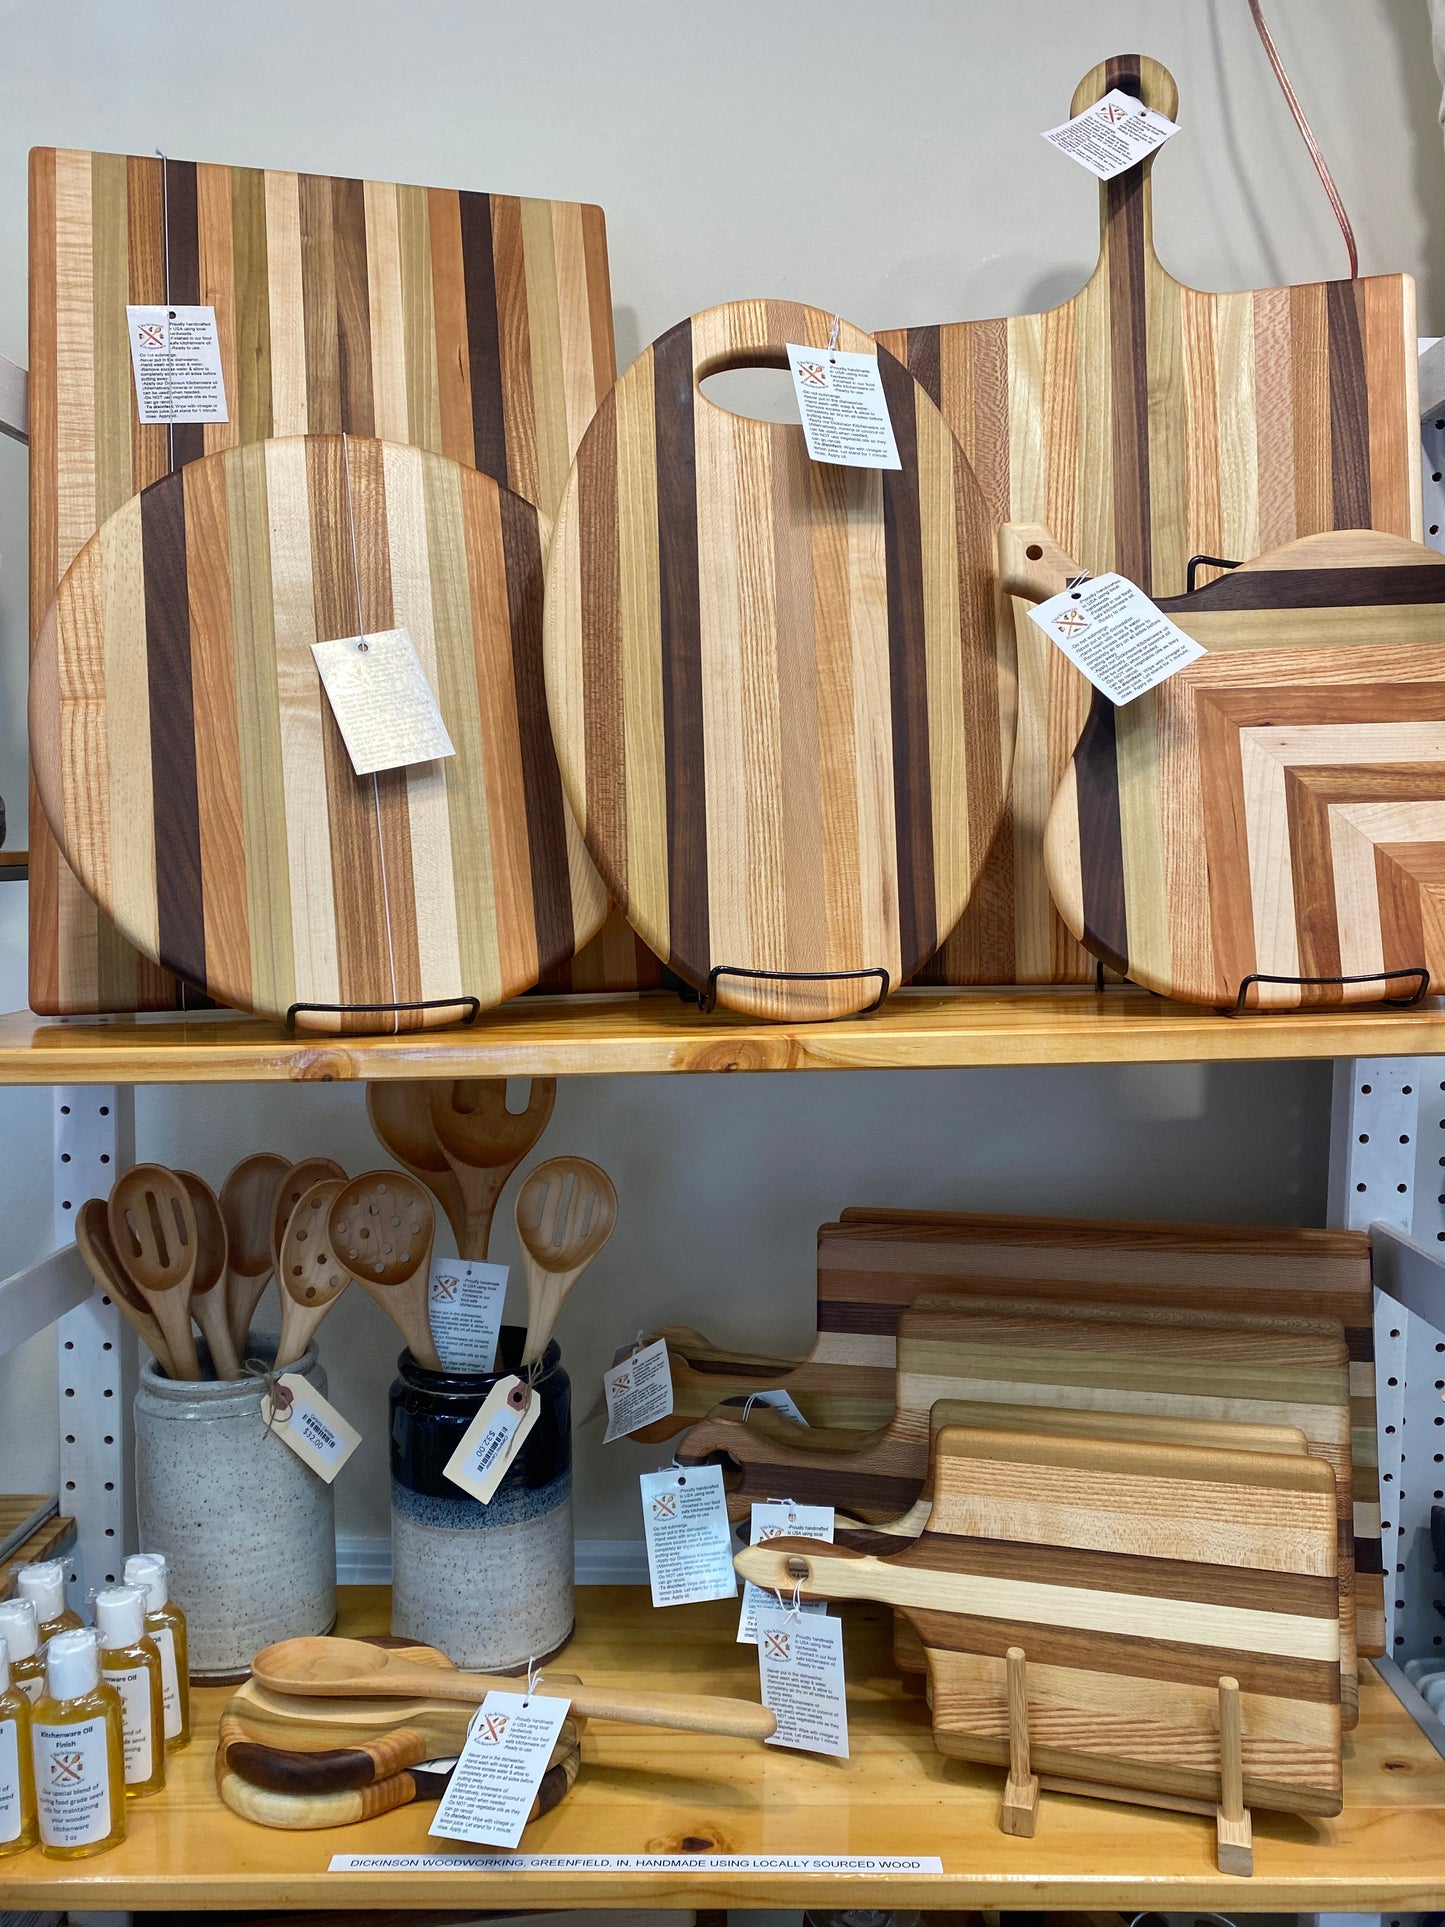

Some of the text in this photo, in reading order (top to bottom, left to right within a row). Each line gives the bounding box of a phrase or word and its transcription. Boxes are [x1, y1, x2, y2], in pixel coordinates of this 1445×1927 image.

[303, 1428, 324, 1449] $32.00
[476, 1430, 496, 1457] $32.00
[41, 1731, 81, 1739] Kitchenware
[74, 1786, 91, 1795] blend
[70, 1797, 88, 1806] grade
[90, 1792, 104, 1800] seed
[62, 1802, 98, 1814] maintaining
[66, 1814, 90, 1823] wooden
[53, 1824, 89, 1832] kitchenware
[350, 1859, 420, 1867] DICKINSON
[421, 1859, 527, 1868] WOODWORKING,
[530, 1860, 613, 1868] GREENFIELD,
